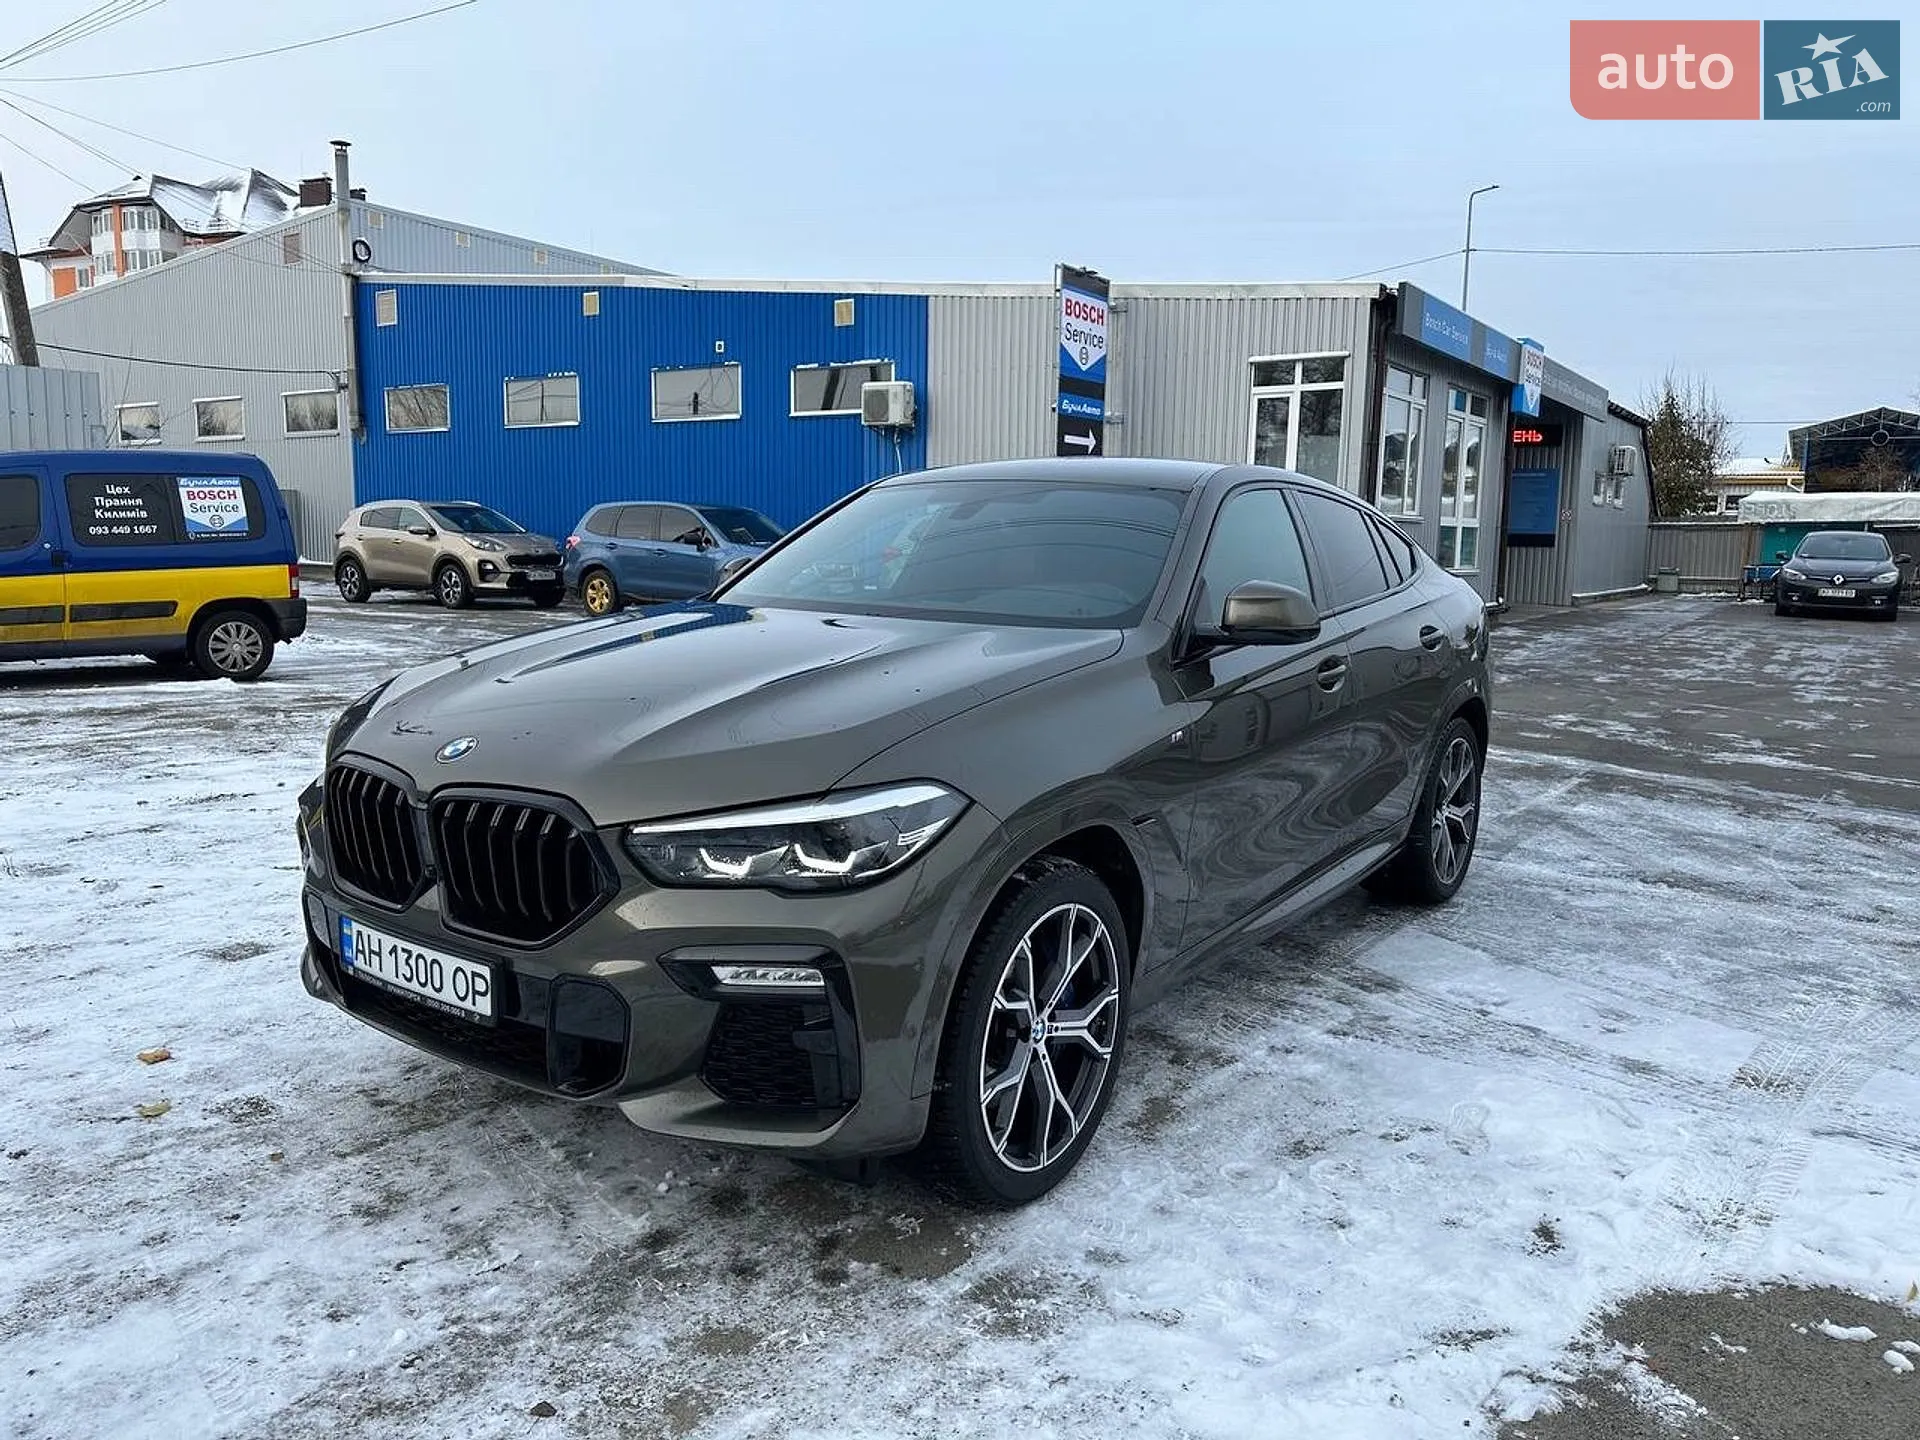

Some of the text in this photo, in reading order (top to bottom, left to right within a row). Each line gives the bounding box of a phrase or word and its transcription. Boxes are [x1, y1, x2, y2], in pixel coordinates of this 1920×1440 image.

[1064, 298, 1105, 326] BOSCH
[1064, 322, 1104, 350] Service
[186, 489, 237, 500] BOSCH
[94, 496, 143, 508] Прання
[190, 502, 239, 513] Service
[94, 508, 148, 519] Килимів
[88, 526, 110, 535] 093
[355, 929, 384, 972] AH
[388, 944, 444, 993] 1300
[452, 966, 490, 1006] OP
